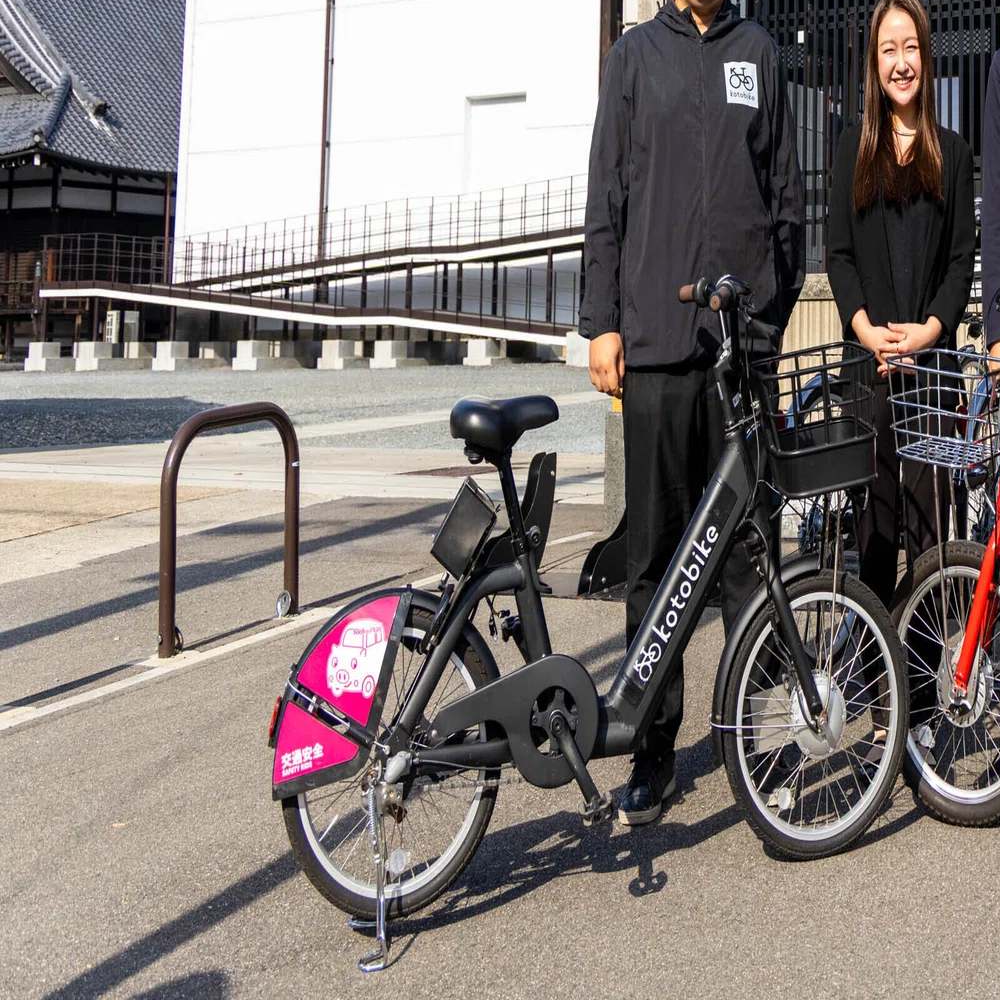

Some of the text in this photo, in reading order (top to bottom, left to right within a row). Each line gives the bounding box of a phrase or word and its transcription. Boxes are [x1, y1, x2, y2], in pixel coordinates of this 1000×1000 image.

[730, 90, 755, 101] kotobike
[652, 525, 719, 643] kotobike
[281, 742, 324, 769] 交通安全
